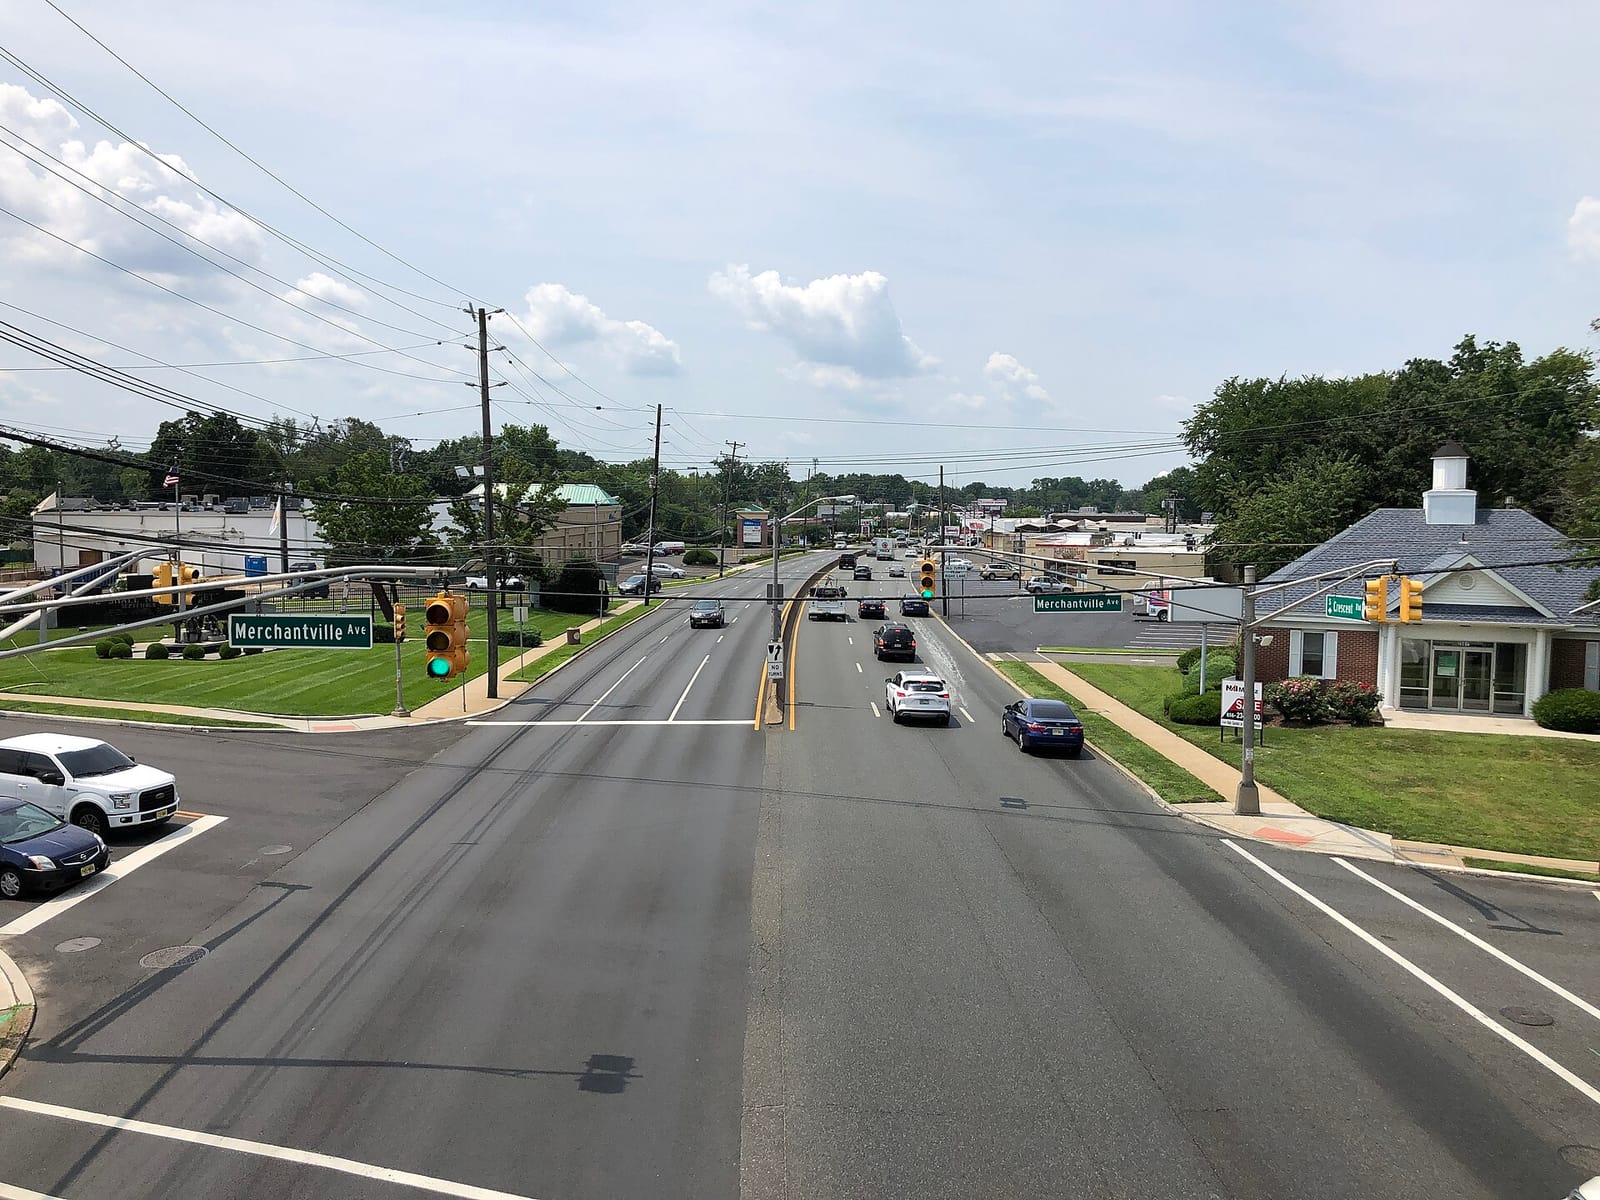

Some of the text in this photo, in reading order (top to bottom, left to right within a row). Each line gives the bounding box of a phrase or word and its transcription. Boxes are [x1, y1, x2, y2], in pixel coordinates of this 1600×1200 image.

[1036, 599, 1104, 609] Merchantville
[1333, 601, 1354, 614] Crescent
[235, 622, 367, 641] Merchantville Ave
[1235, 699, 1261, 712] SE
